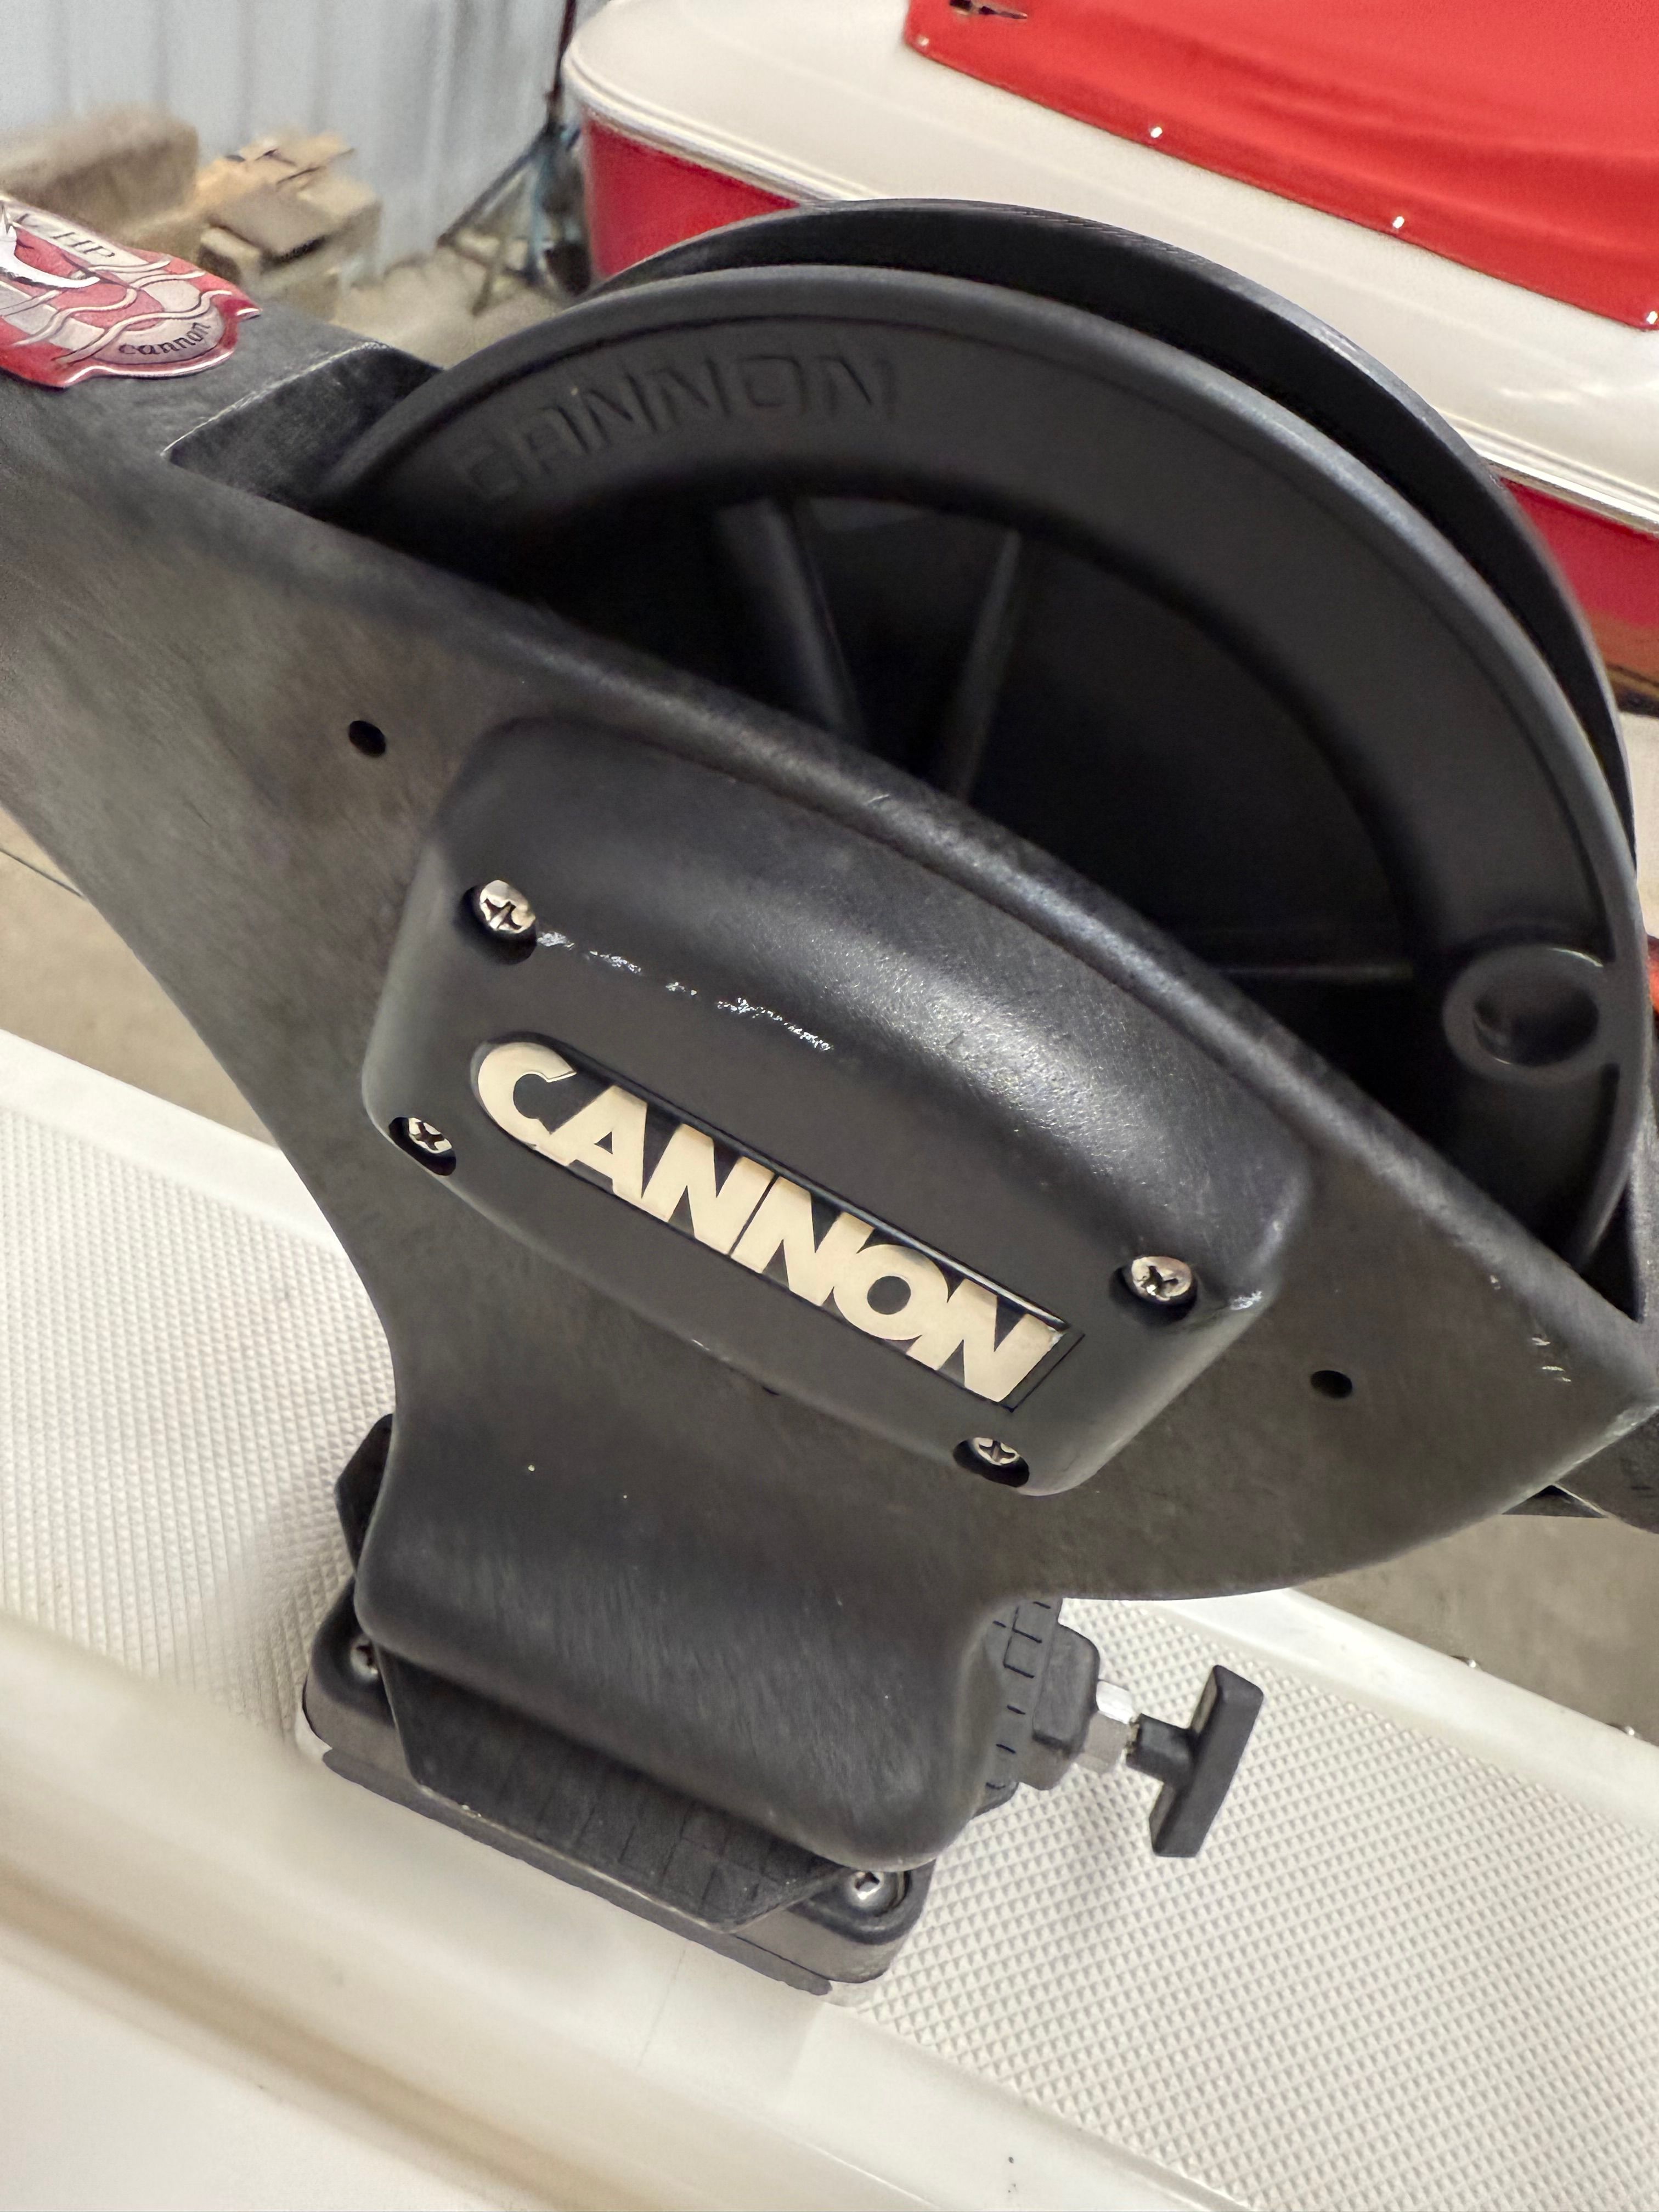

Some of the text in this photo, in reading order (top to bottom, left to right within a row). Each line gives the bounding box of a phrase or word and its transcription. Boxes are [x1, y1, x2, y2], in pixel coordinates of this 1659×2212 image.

[119, 322, 211, 355] cannon
[452, 353, 899, 500] CANNON
[476, 1041, 1065, 1402] CANNON
